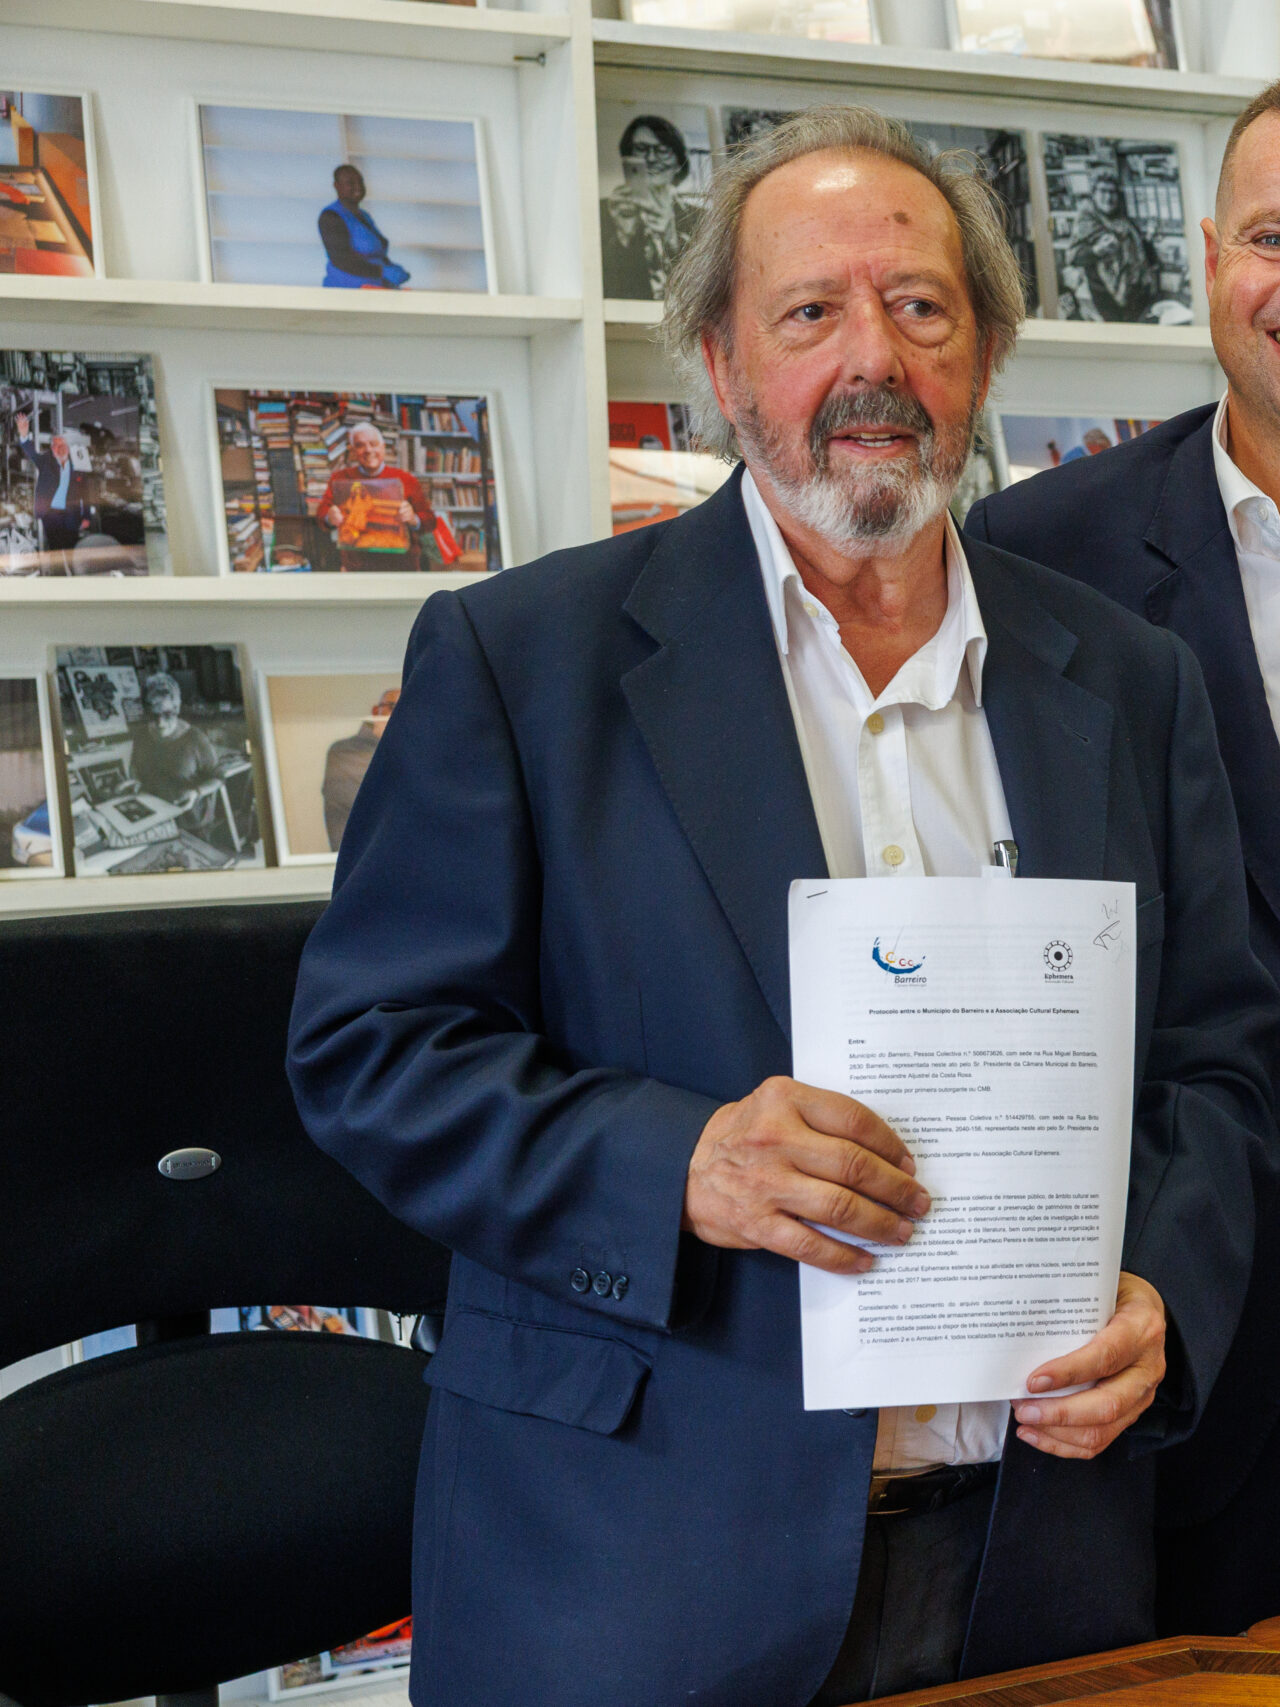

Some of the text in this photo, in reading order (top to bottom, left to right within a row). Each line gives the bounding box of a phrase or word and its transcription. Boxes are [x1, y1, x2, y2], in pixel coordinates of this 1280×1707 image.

[894, 975, 927, 984] Barreiro
[922, 1007, 951, 1015] Município
[995, 1007, 1028, 1015] Associação
